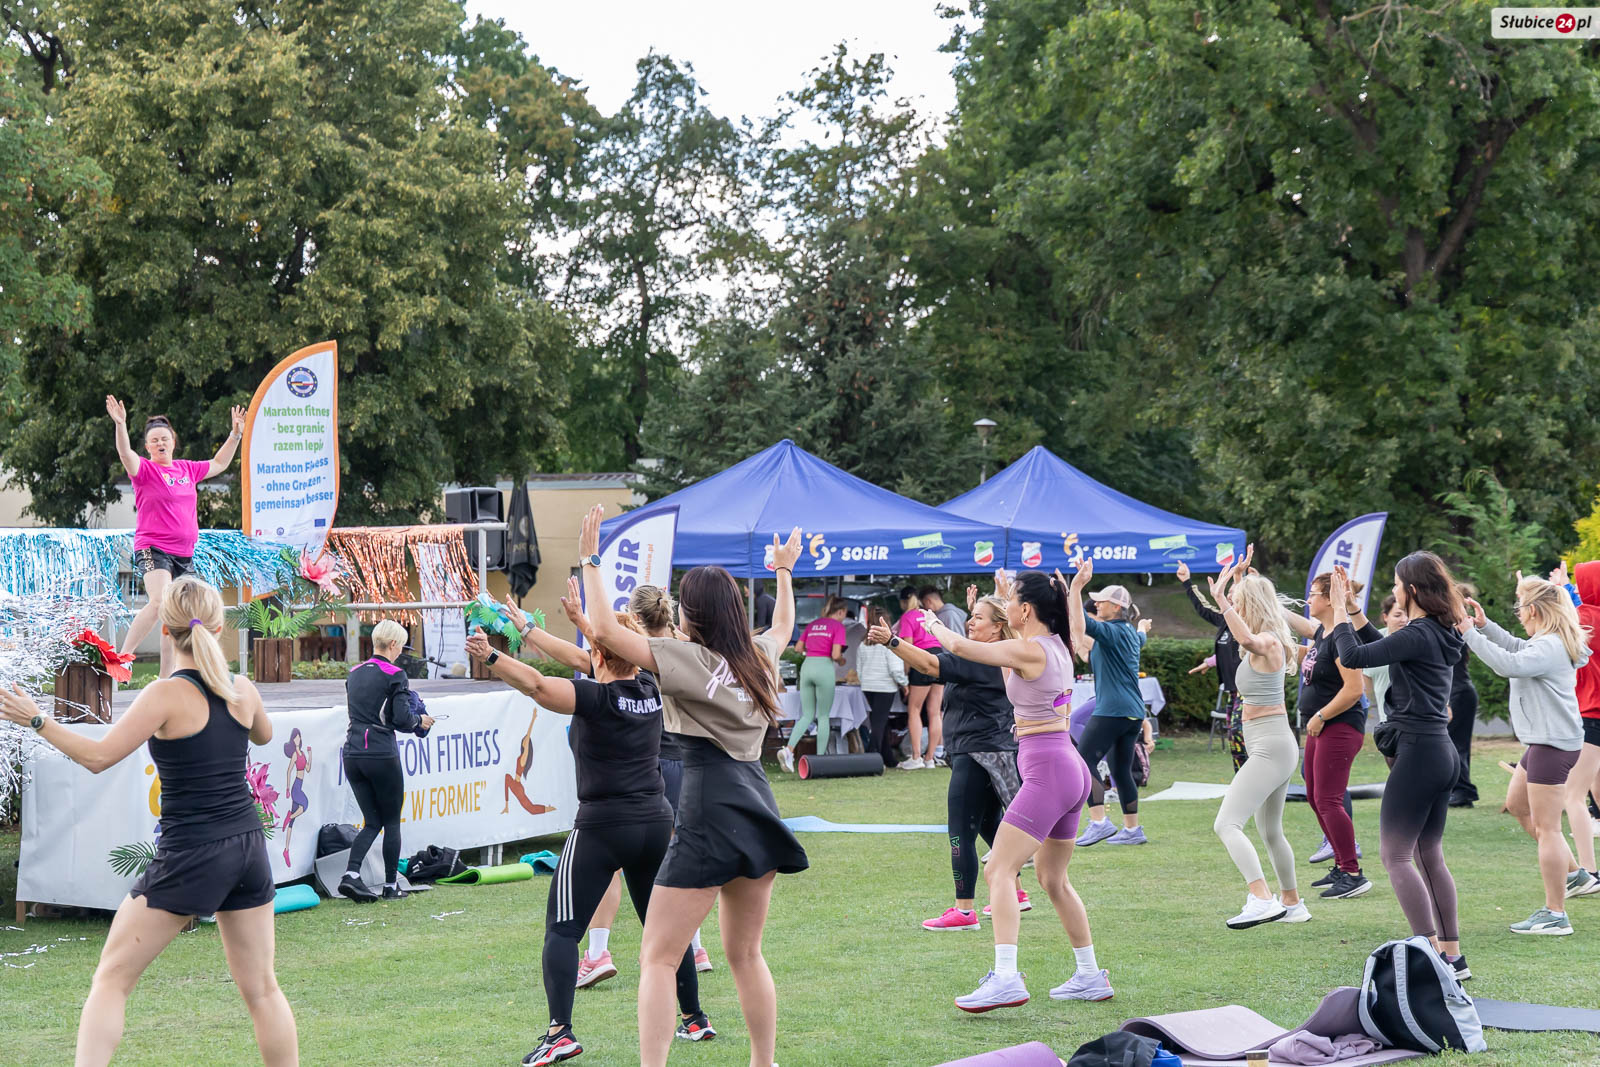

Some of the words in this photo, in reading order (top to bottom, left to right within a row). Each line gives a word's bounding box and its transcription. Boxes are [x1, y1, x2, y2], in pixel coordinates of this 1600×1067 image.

[263, 406, 303, 417] Maraton
[277, 422, 295, 433] bez
[296, 421, 325, 436] granic
[273, 441, 303, 451] razem
[257, 461, 303, 474] Marathon
[266, 479, 291, 491] ohne
[437, 728, 501, 773] FITNESS
[410, 785, 426, 821] W
[951, 835, 964, 890] ZUBA
